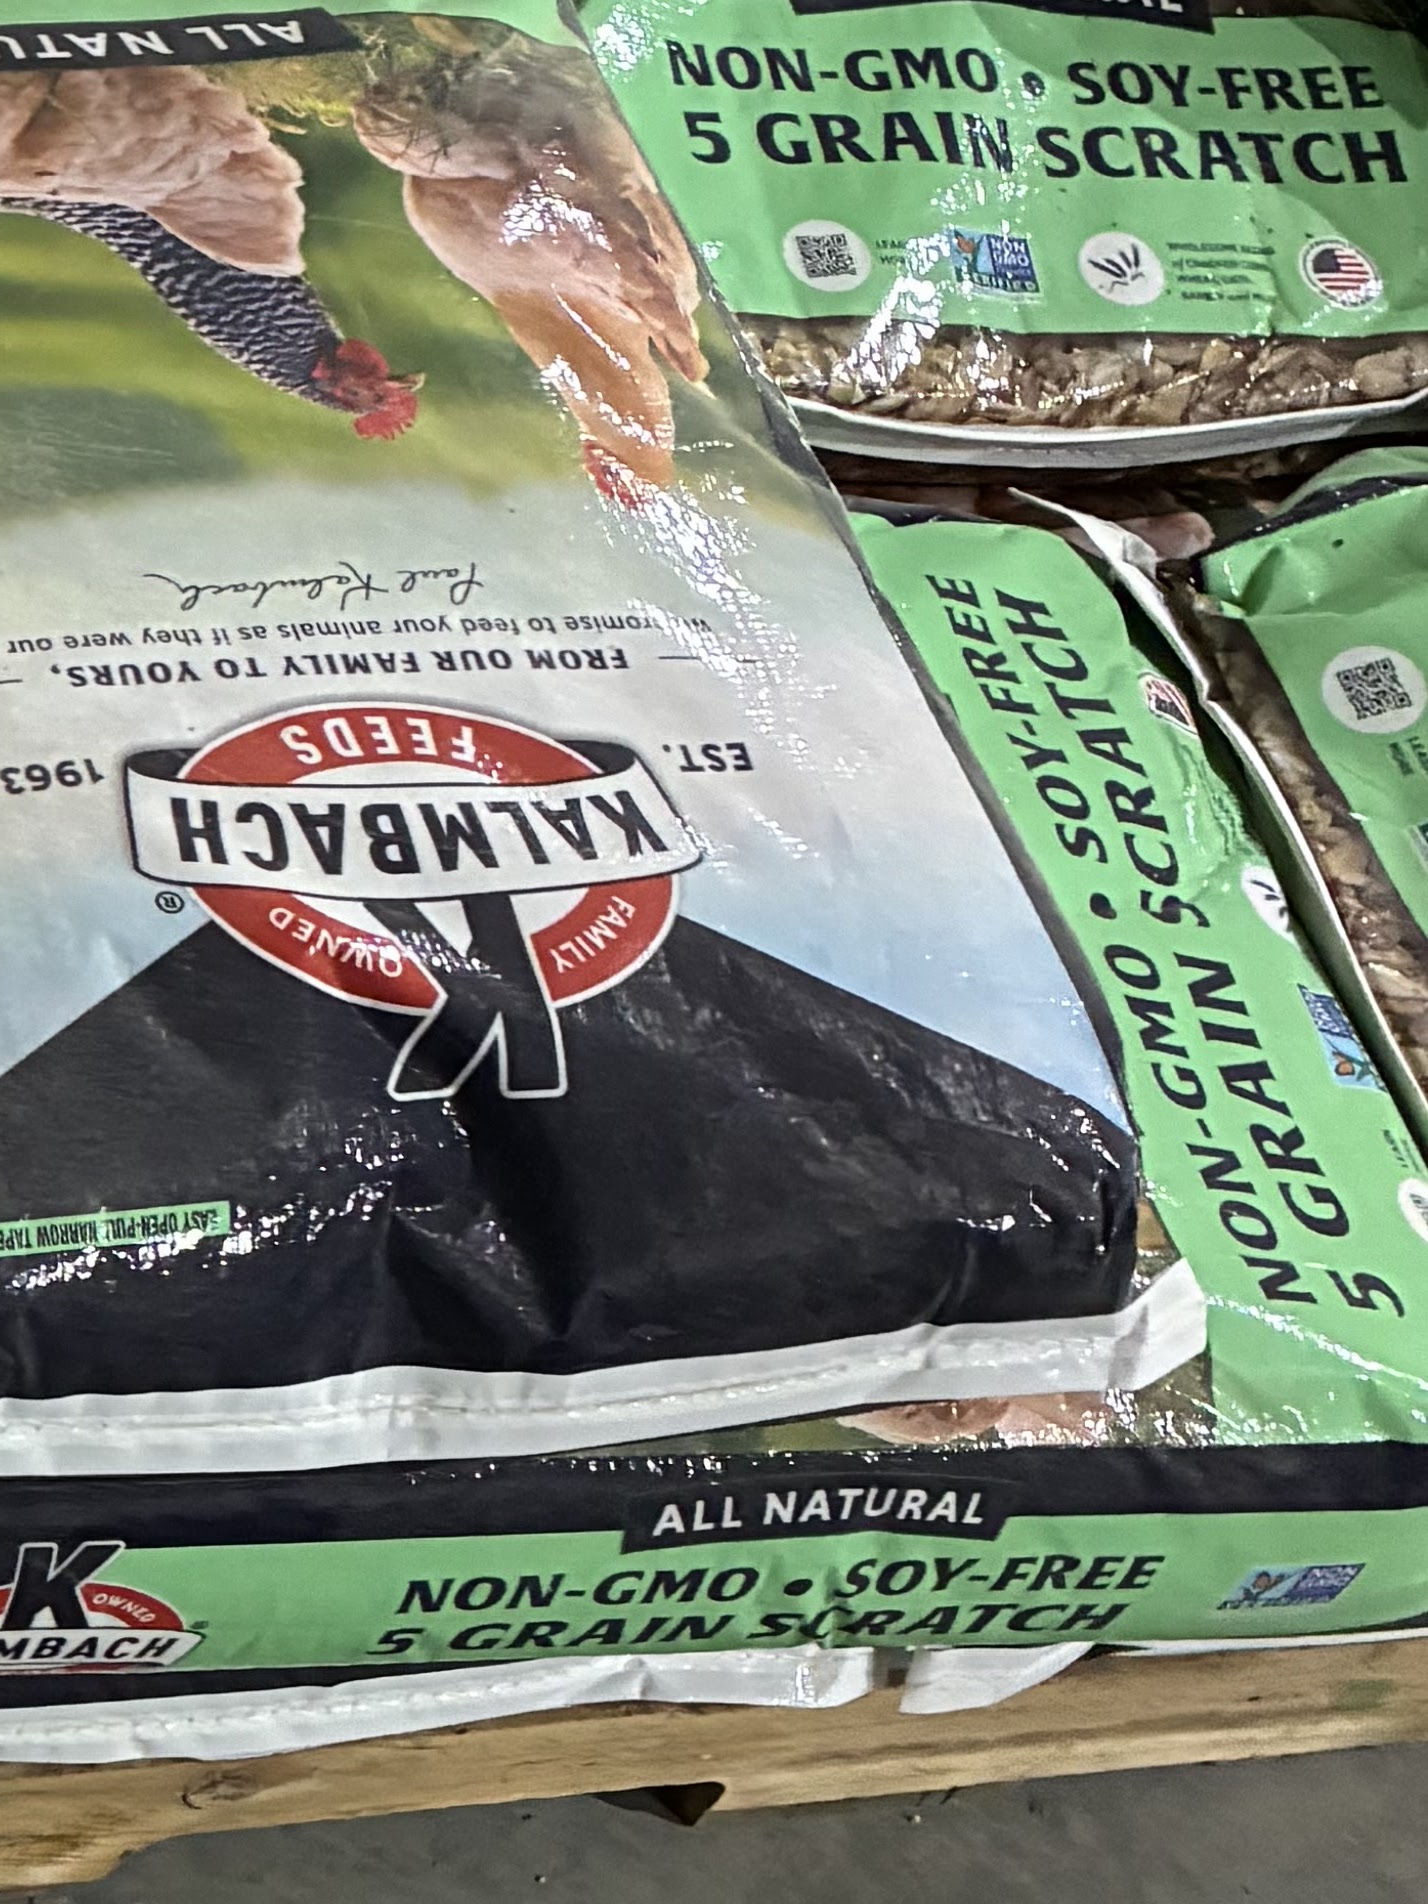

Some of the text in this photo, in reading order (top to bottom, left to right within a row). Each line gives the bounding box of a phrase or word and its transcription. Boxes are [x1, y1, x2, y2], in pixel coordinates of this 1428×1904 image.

[184, 19, 307, 52] ALL
[666, 37, 1387, 112] NON-GMO SOY-FREE
[685, 109, 1410, 187] 5 GRAIN SCRATCH
[64, 631, 133, 651] were
[143, 627, 203, 646] they
[211, 625, 232, 643] if
[239, 625, 268, 641] as
[278, 620, 381, 639] animals
[392, 615, 450, 636] your
[462, 617, 522, 637] feed
[528, 616, 557, 633] to
[564, 612, 662, 634] romise
[7, 637, 53, 654] our
[49, 647, 632, 688] FROM OUR FAMILY TO YOURS,
[280, 715, 478, 764] FEEDS
[662, 741, 755, 773] EST.
[0, 758, 106, 795] 1963
[994, 586, 1212, 933] SCRATCH
[168, 790, 670, 874] KALMBACH
[268, 895, 637, 978] FAMILY OWNED
[922, 571, 1322, 1308] NON-GMO SOY-FREE
[1176, 948, 1351, 1237] GRAIN
[1325, 1268, 1406, 1320] 5
[652, 1490, 985, 1537] ALL NATURAL
[395, 1554, 1167, 1615] NON-GMO SOY-FREE
[91, 1592, 157, 1624] OWNED
[366, 1601, 1134, 1656] 5 GRAIN SCRATCH
